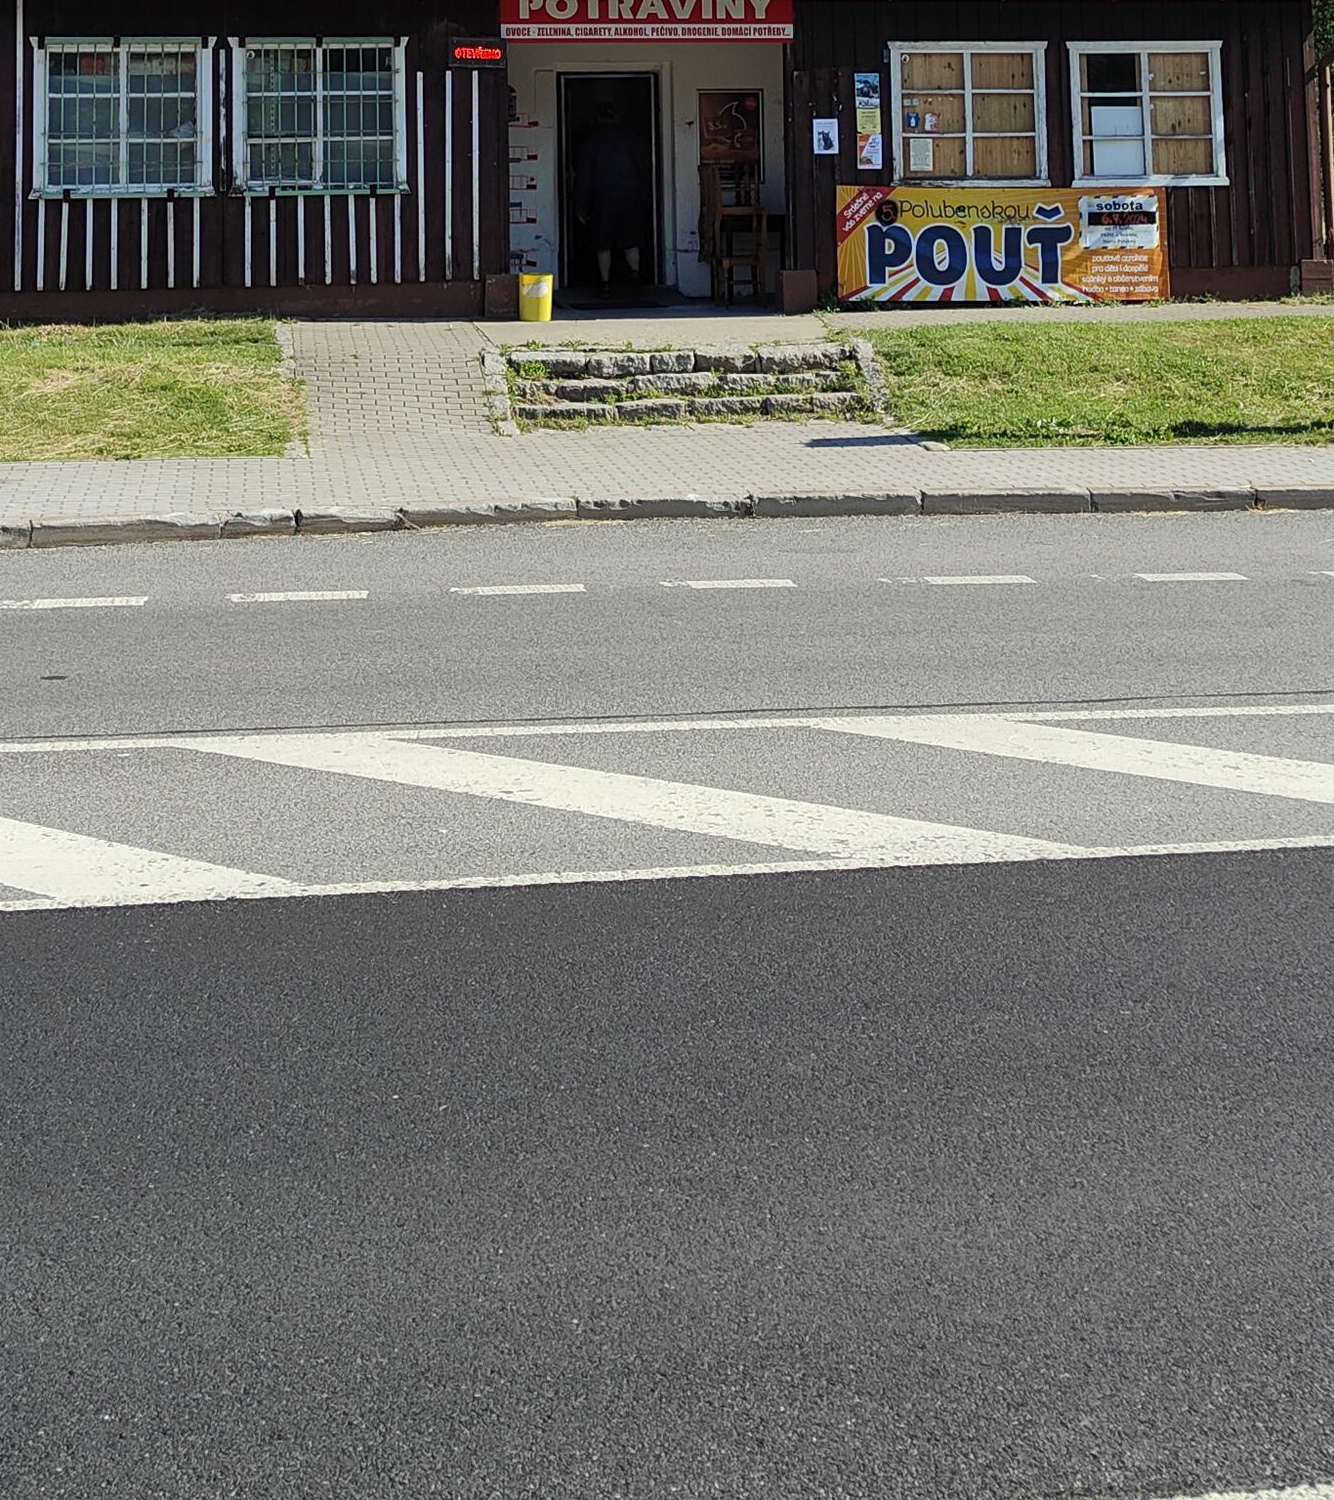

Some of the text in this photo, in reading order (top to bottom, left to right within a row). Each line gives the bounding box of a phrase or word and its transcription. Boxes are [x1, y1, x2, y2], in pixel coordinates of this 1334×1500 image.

[505, 26, 531, 37] OVOCE
[537, 26, 573, 37] ZELENINA,
[575, 26, 613, 37] CIGARETY,
[614, 26, 650, 37] ALKOHOL,
[651, 25, 680, 37] PEČIVO,
[721, 25, 752, 37] DOMÁCÍ
[899, 200, 1031, 219] Polubenskou
[1095, 200, 1144, 211] sobota
